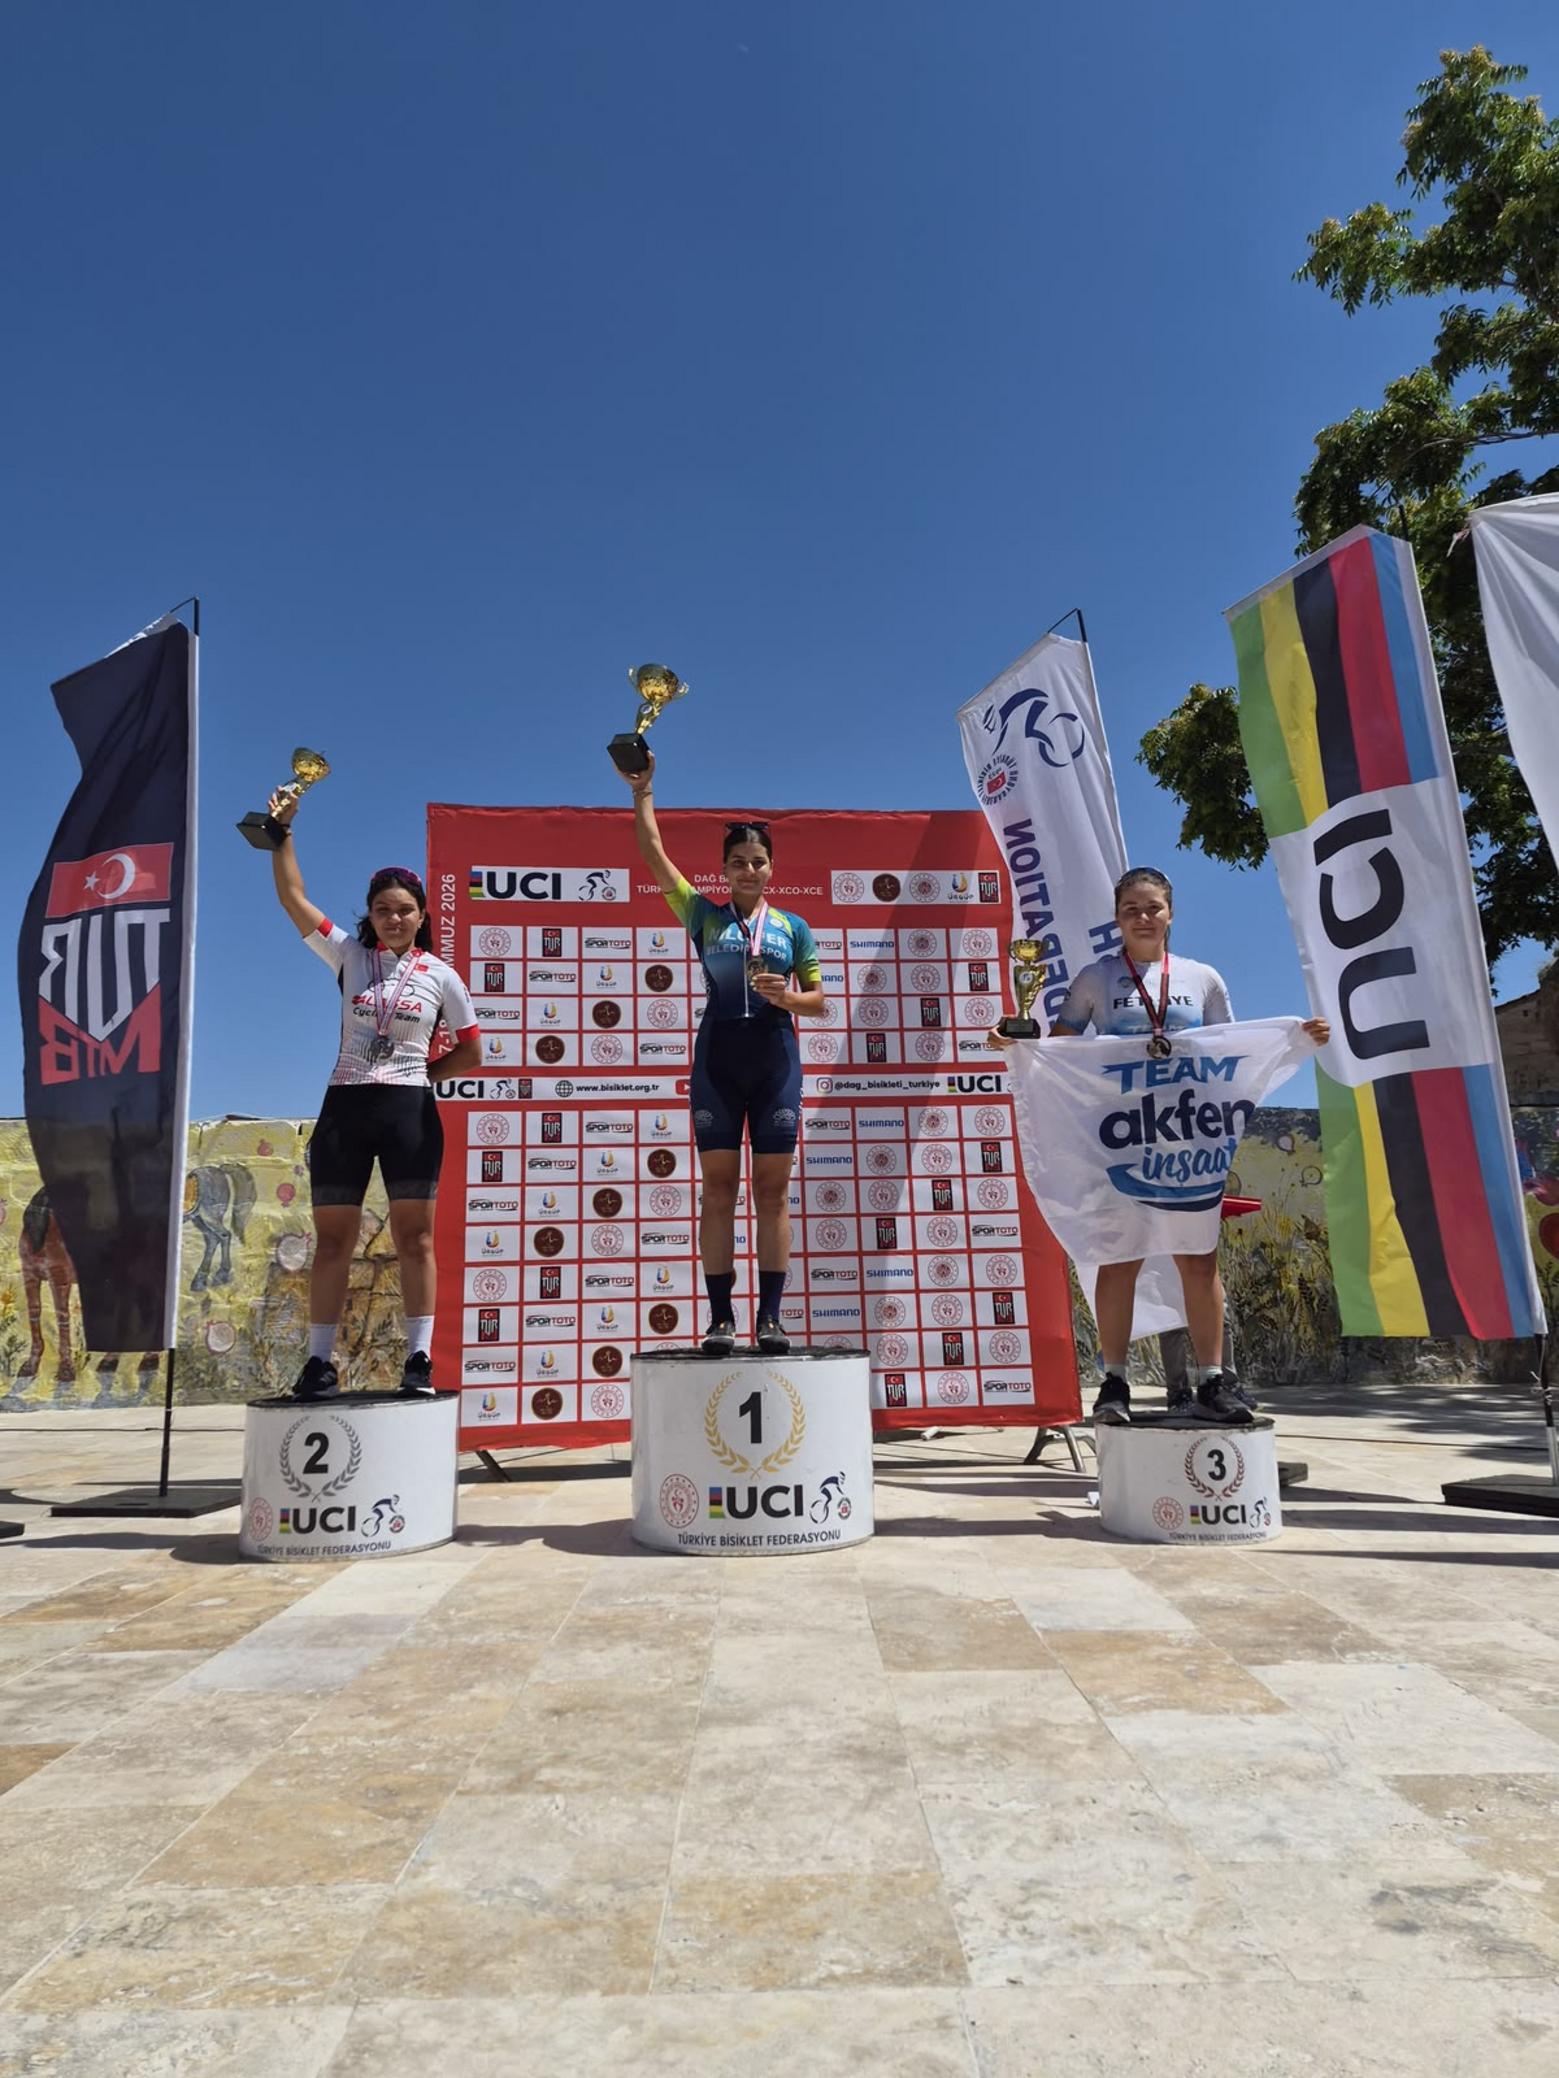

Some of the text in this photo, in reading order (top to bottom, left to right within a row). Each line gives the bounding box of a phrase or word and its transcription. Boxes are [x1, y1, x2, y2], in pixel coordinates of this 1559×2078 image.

[441, 873, 456, 912] 2026
[486, 871, 562, 900] UCI
[441, 916, 456, 969] MMUZ
[436, 1080, 484, 1099] UCI
[576, 1082, 660, 1094] www.bisiklet.org.tr
[958, 1075, 1002, 1093] UCI
[1101, 1055, 1251, 1095] TEAM
[1099, 1089, 1256, 1150] akfen
[739, 1392, 762, 1444] 1
[302, 1432, 329, 1475] 2
[1207, 1449, 1227, 1481] 3
[726, 1484, 804, 1519] UCI
[1201, 1505, 1247, 1525] UCI
[293, 1506, 356, 1534] UCI
[322, 1540, 392, 1555] FEDERASYONU
[678, 1529, 841, 1547] TÜRKİYE BİSİKLET FEDERASYONU
